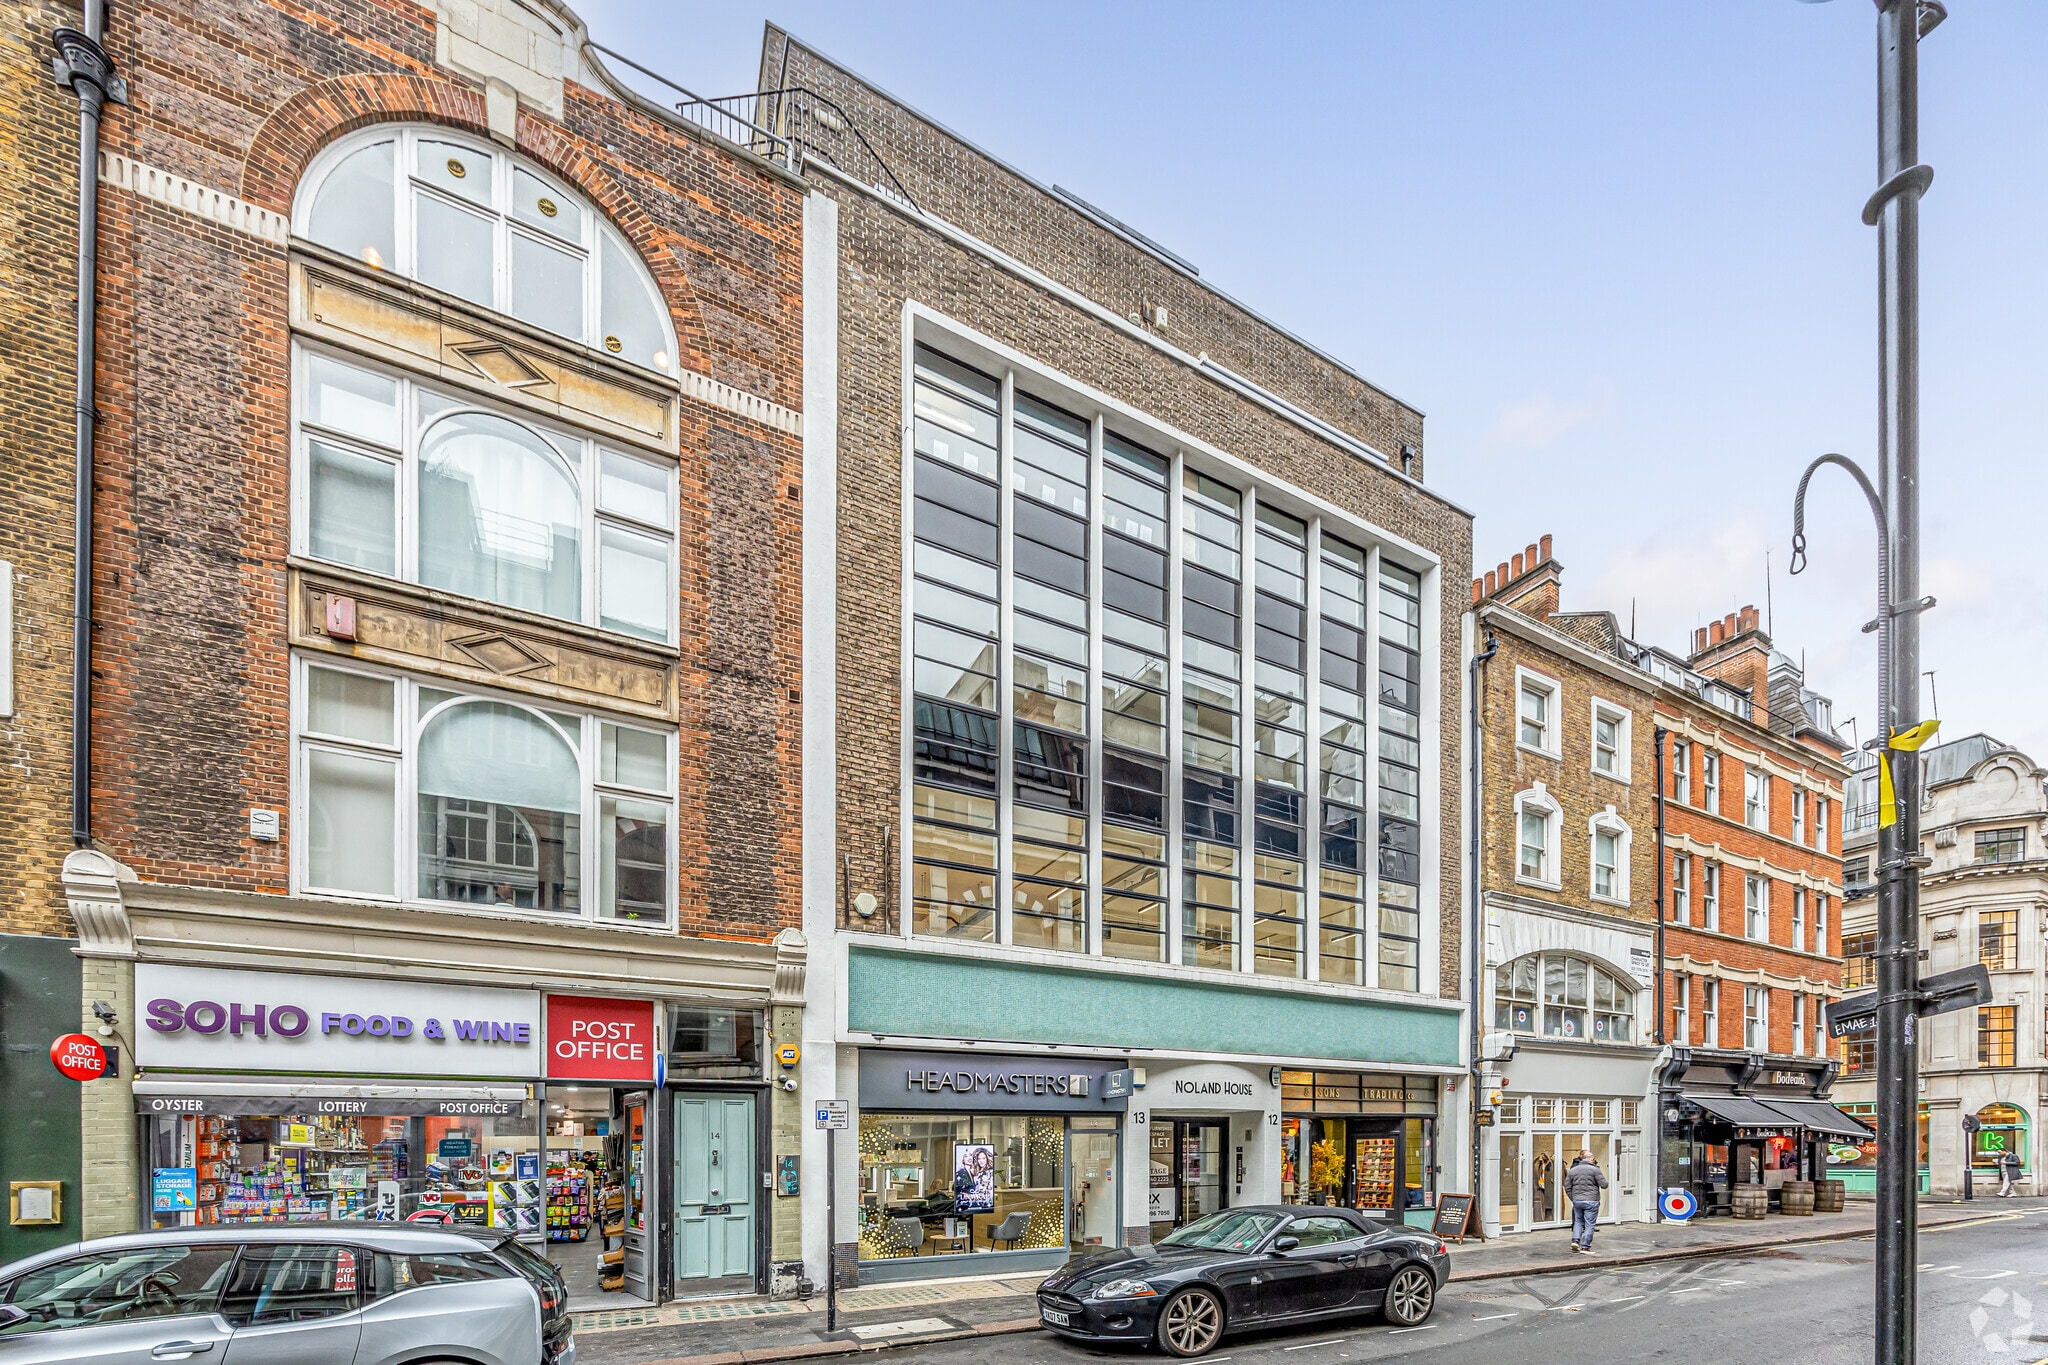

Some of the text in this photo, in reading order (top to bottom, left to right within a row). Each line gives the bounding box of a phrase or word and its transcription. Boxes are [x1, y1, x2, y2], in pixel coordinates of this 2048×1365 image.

[146, 998, 531, 1043] SOHO FOOD & WINE
[572, 1020, 636, 1040] POST
[69, 1042, 97, 1057] POST
[555, 1040, 644, 1060] OFFICE
[61, 1055, 101, 1071] OFFICE
[907, 1069, 1068, 1095] HEADMASTERS
[1175, 1080, 1252, 1096] NOLAND HOUSE
[1317, 1088, 1341, 1098] SONS
[1363, 1089, 1403, 1100] TRADING
[152, 1099, 204, 1111] OYSTER
[318, 1101, 367, 1113] LOTTERY
[440, 1103, 508, 1114] POST OFFICE
[1133, 1112, 1145, 1124] 13
[1268, 1114, 1278, 1126] 12
[711, 1132, 721, 1140] 14
[1152, 1138, 1171, 1148] LET
[784, 1160, 793, 1168] 14
[459, 1207, 484, 1217] VIP
